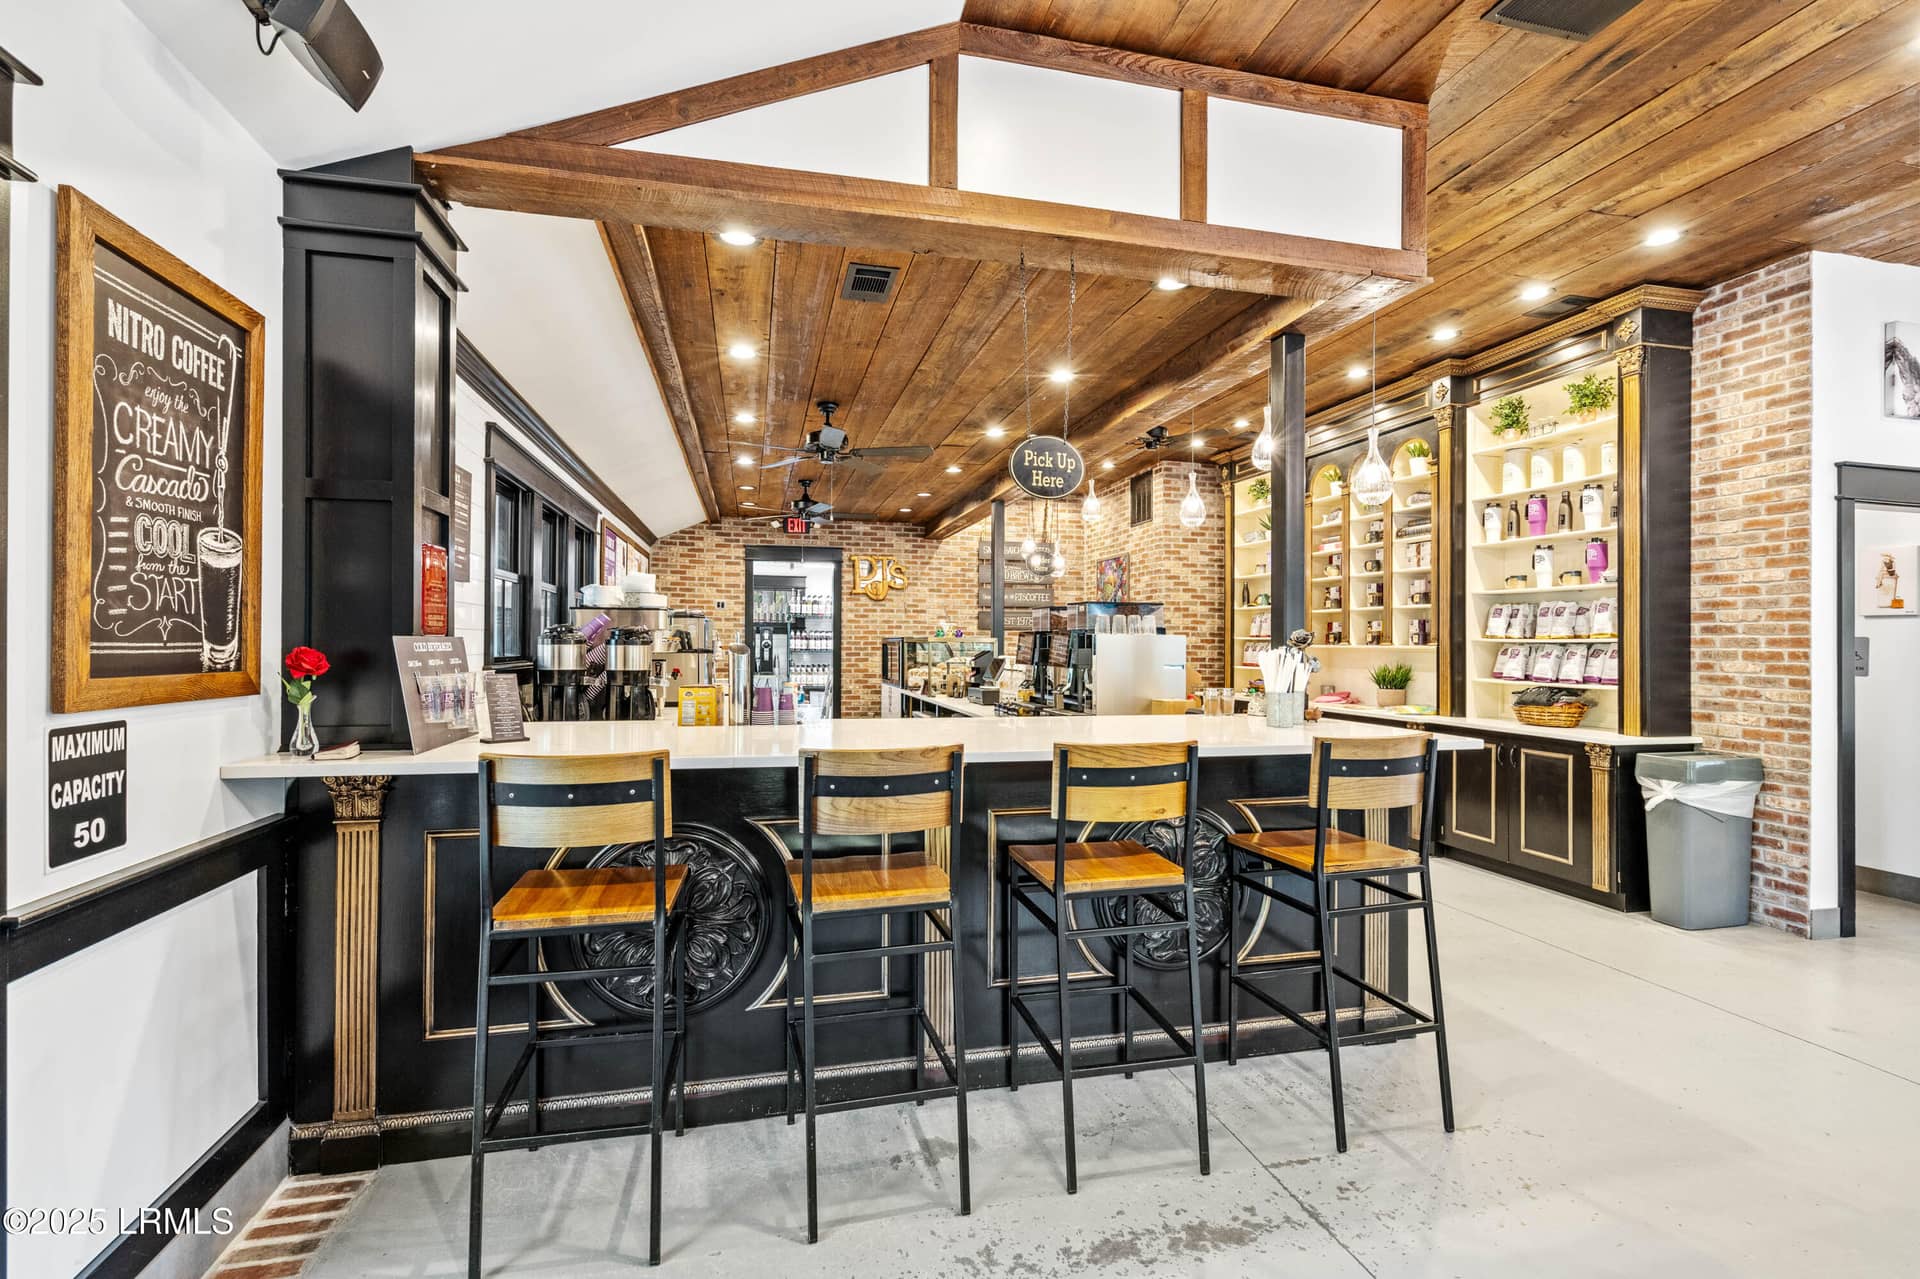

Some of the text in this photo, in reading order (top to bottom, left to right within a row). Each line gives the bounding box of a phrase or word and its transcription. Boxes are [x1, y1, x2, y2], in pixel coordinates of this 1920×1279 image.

[108, 298, 226, 392] NITRO COFFEE
[144, 386, 189, 414] enjoy the
[113, 402, 214, 469] CREAMY
[1024, 449, 1076, 473] Pick Up
[115, 454, 209, 502] Cascade
[1032, 470, 1064, 488] Here
[126, 495, 134, 507] &
[135, 497, 176, 516] SMOOTH
[134, 512, 196, 564] COOL
[787, 517, 807, 533] EXIT
[136, 554, 190, 575] from the
[127, 572, 199, 614] START
[51, 727, 125, 762] MAXIMUM
[51, 769, 125, 810] CAPACITY
[73, 817, 106, 848] 50
